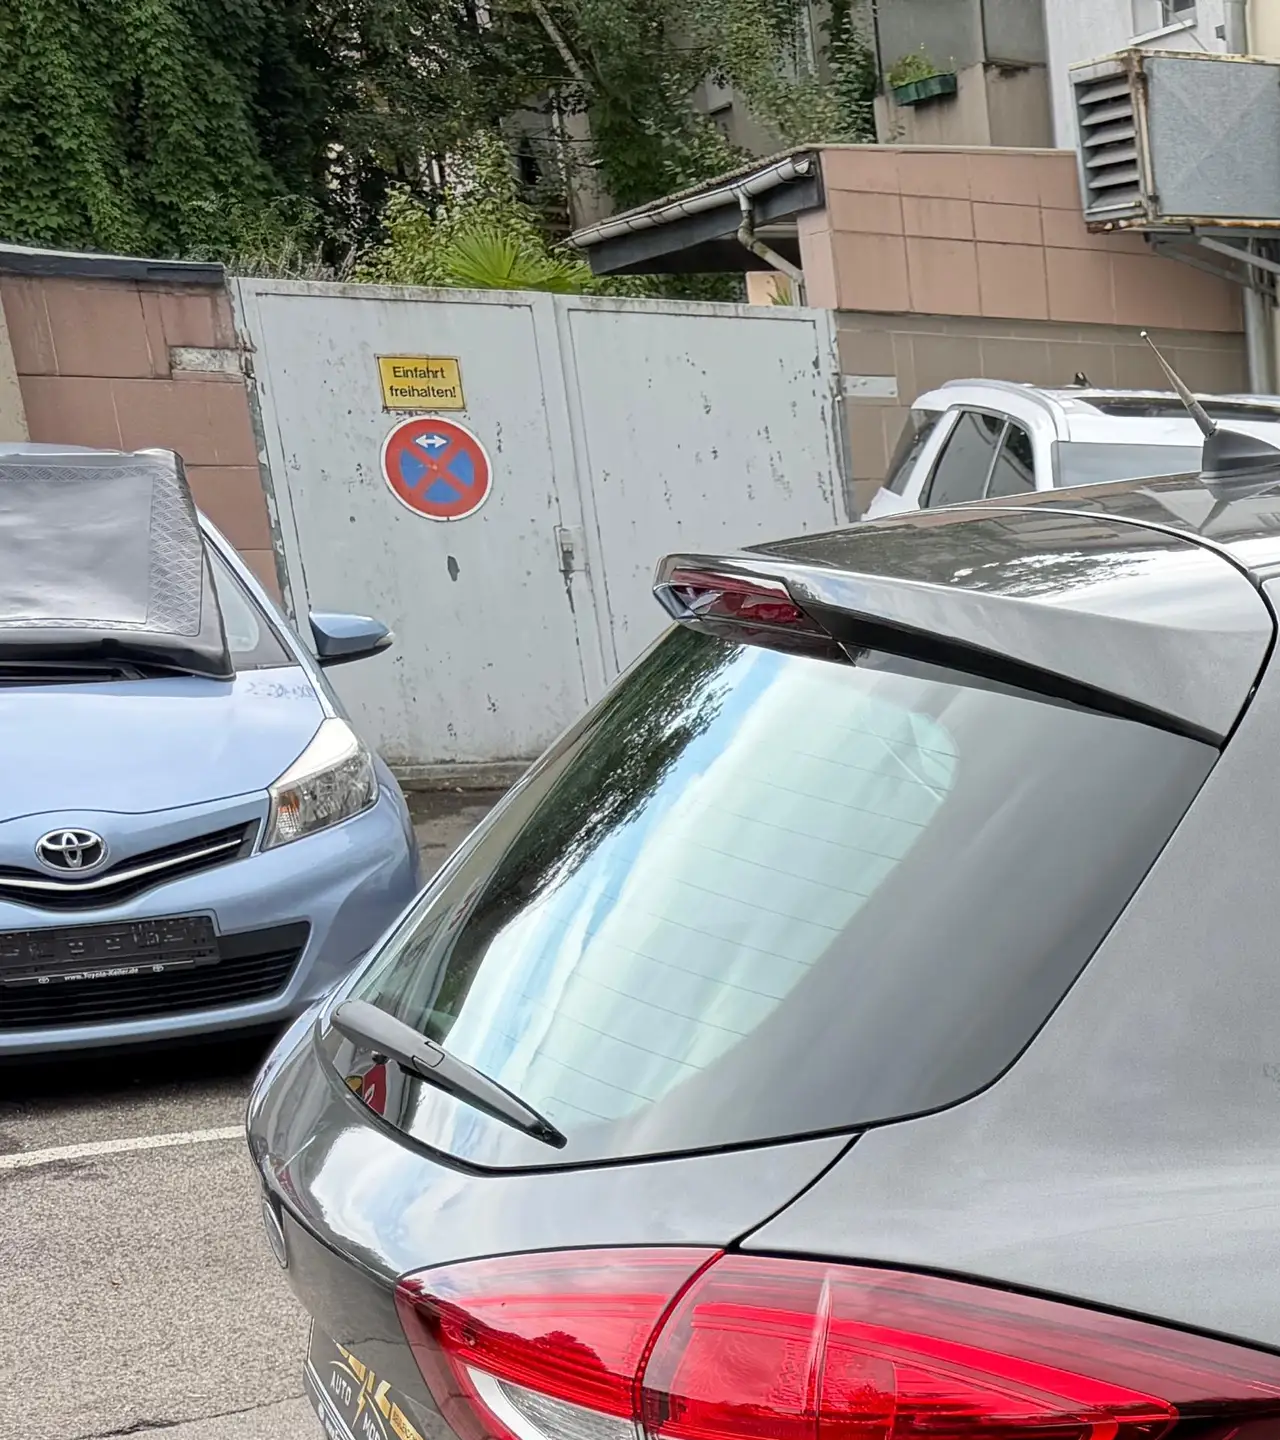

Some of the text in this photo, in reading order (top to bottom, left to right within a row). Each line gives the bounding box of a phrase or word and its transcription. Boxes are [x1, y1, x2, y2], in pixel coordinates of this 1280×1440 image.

[392, 366, 446, 379] Einfahrt
[389, 385, 457, 398] freihalten!
[330, 1371, 352, 1406] AUTO
